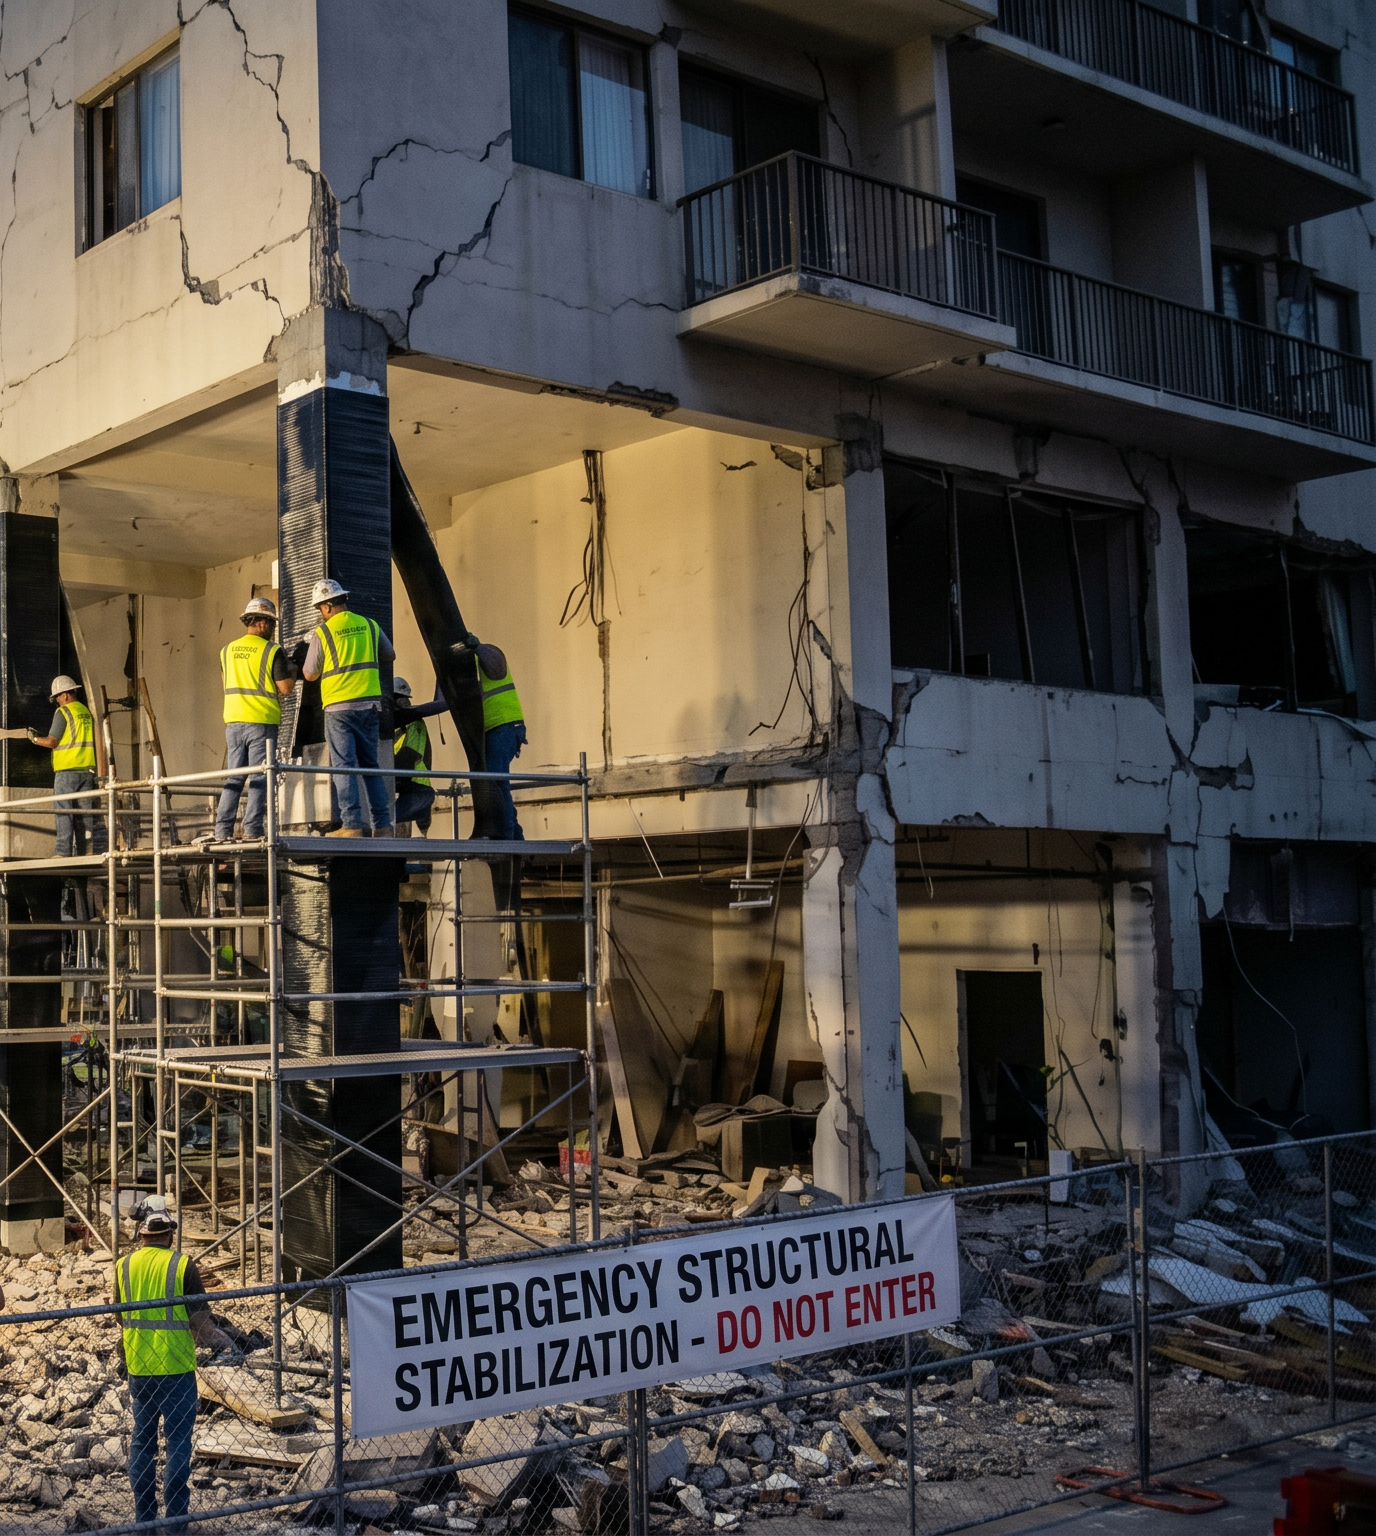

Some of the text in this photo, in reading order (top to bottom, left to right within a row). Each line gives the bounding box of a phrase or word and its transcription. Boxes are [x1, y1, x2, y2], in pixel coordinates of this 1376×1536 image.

[391, 1219, 915, 1349] EMERGENCY STRUCTURAL
[394, 1270, 937, 1412] STABILIZATION - DO NOT ENTER
